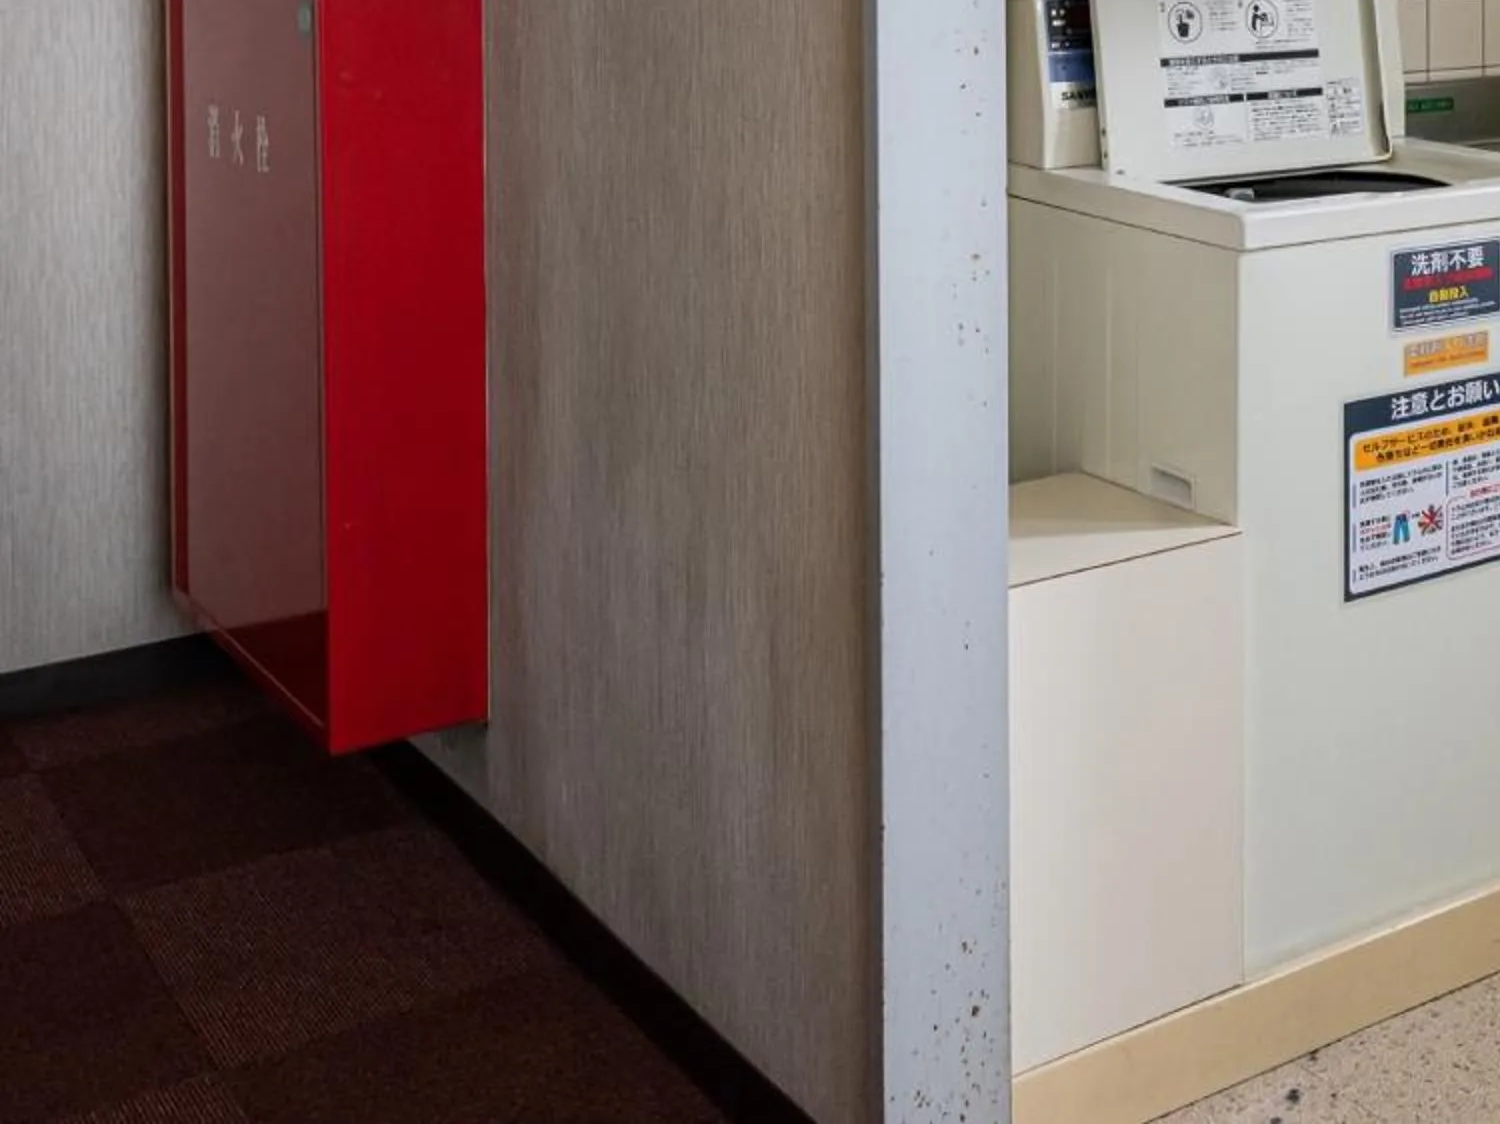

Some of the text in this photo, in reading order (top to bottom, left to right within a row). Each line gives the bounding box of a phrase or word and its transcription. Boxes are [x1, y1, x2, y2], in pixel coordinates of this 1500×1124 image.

[207, 103, 270, 174] 消火栓
[1411, 246, 1485, 276] 洗剤不要
[1391, 379, 1500, 420] 注意とお願い
